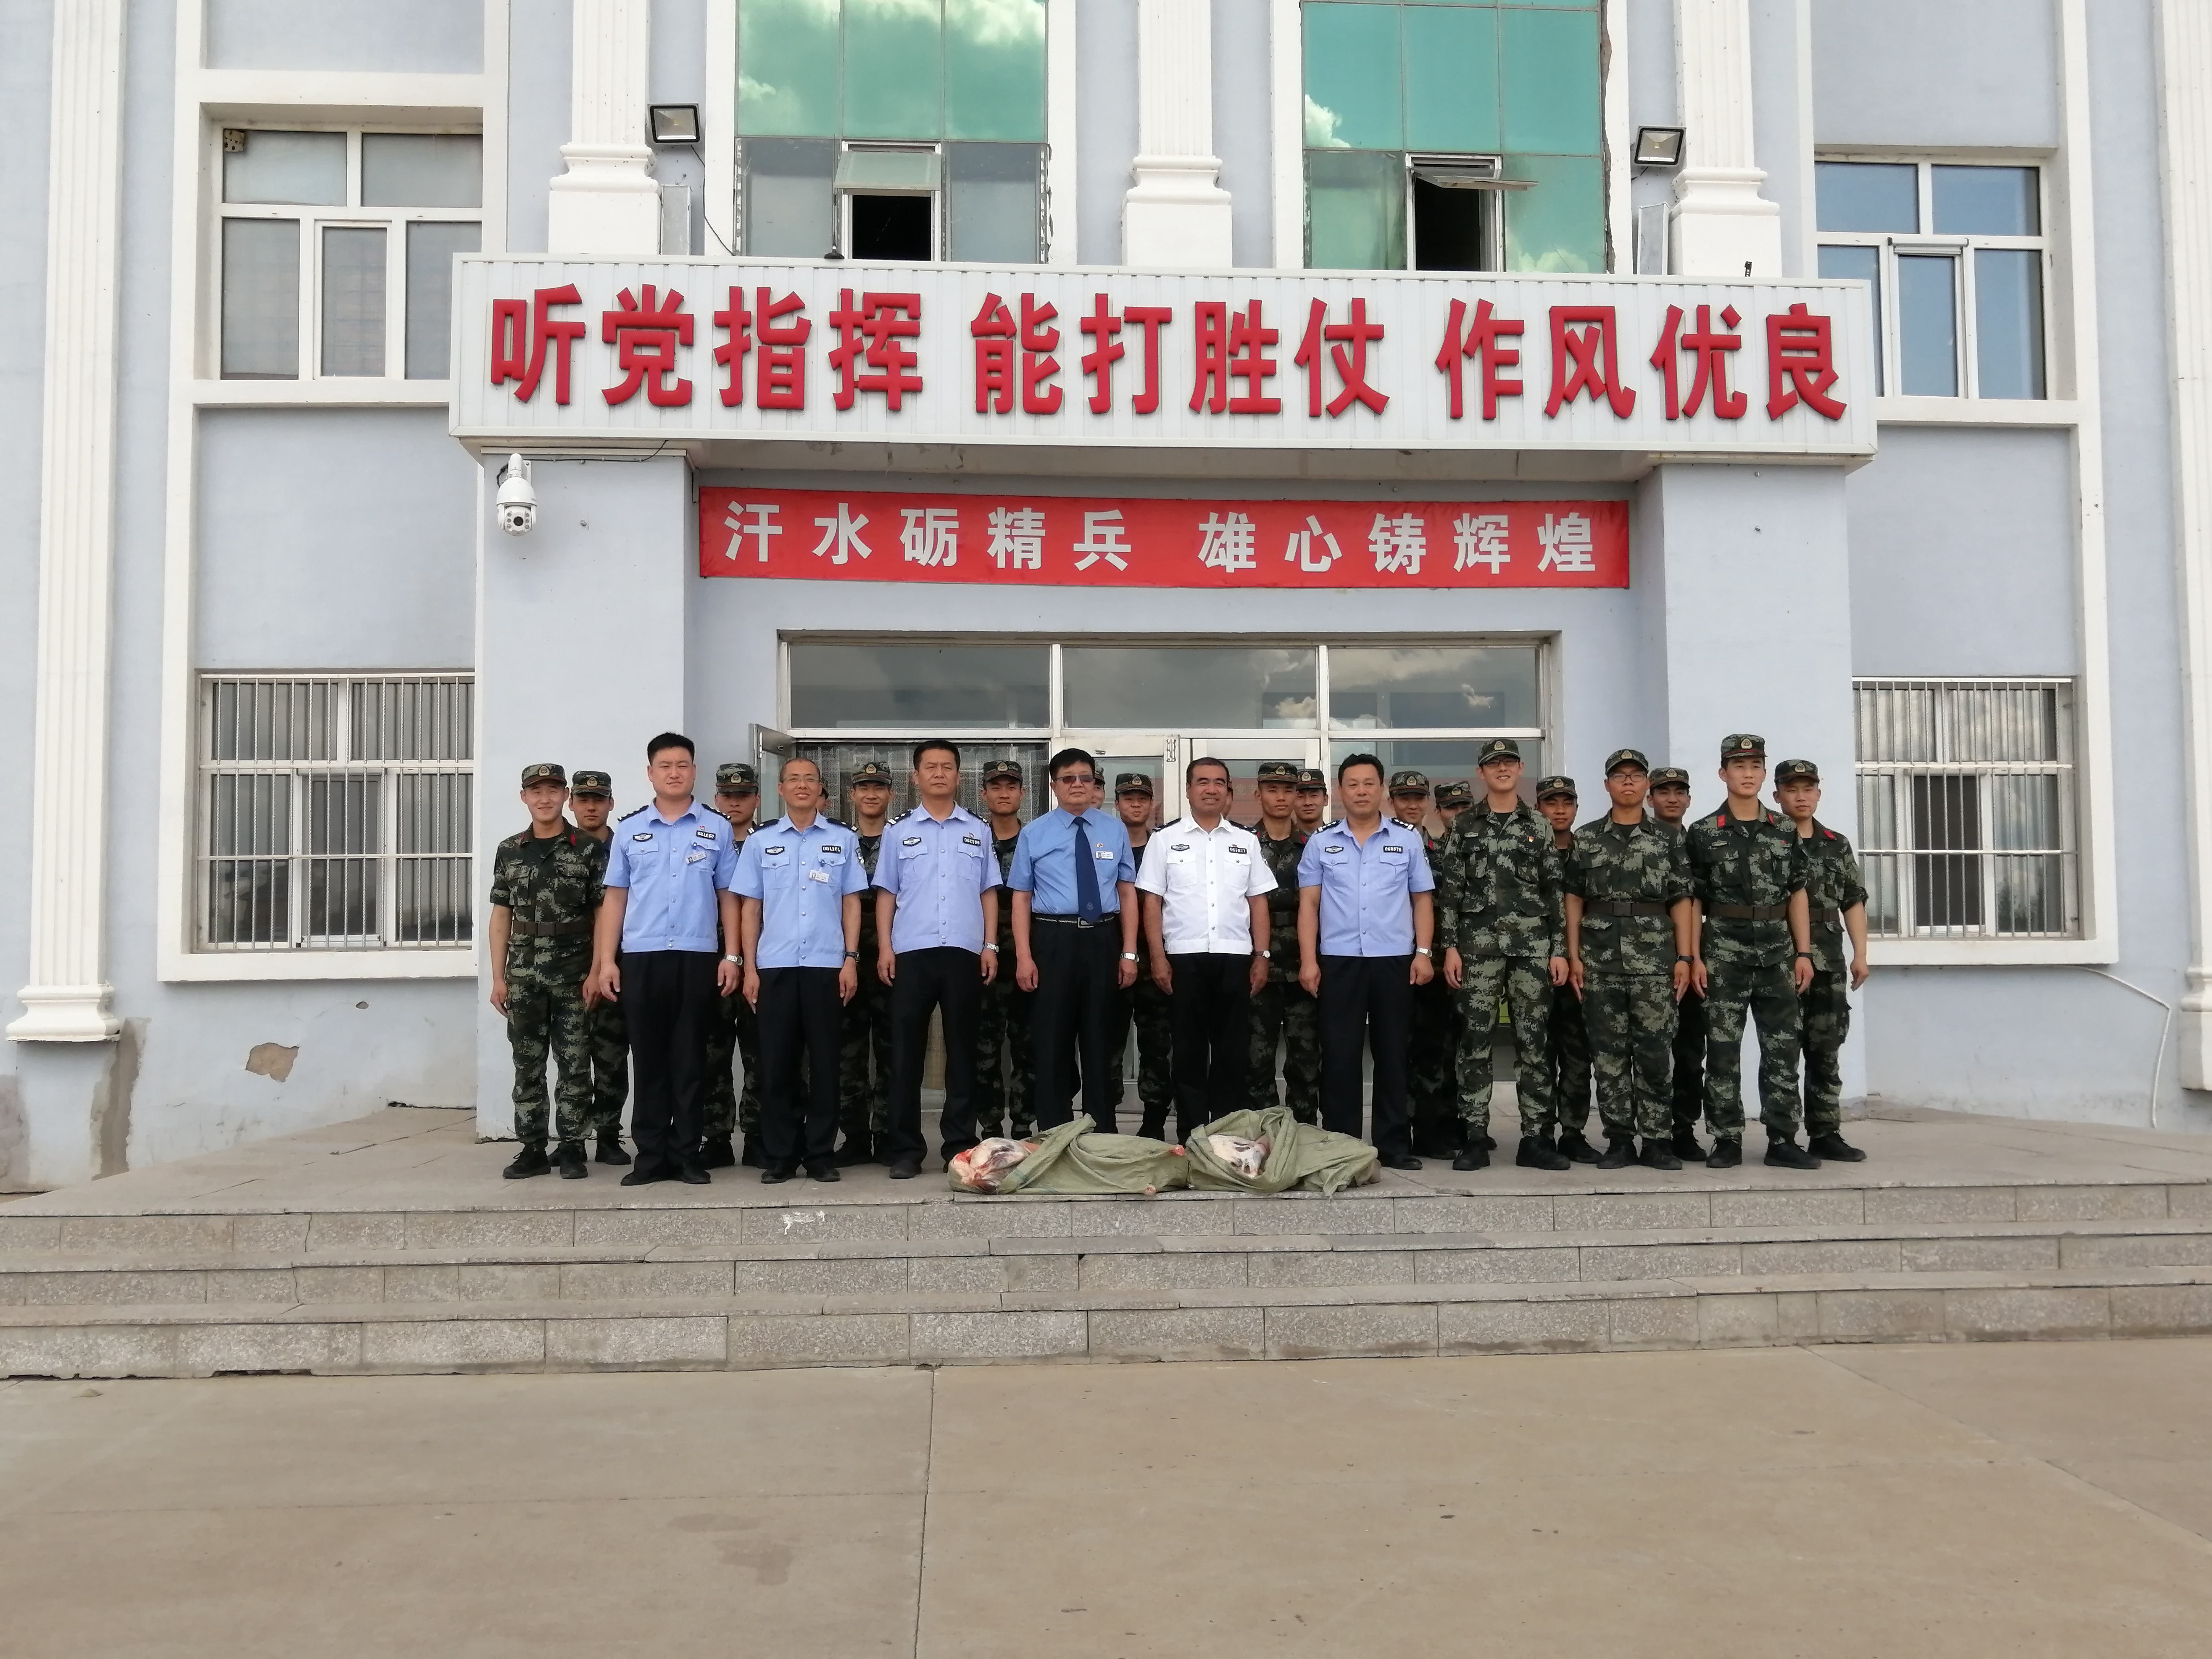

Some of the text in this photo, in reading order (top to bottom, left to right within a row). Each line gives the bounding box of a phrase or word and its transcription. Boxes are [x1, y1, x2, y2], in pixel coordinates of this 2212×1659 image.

[491, 283, 1847, 420] 听党指挥 能打胜仗 作风优良
[724, 501, 1596, 575] 汗水砺精兵 雄心铸辉煌
